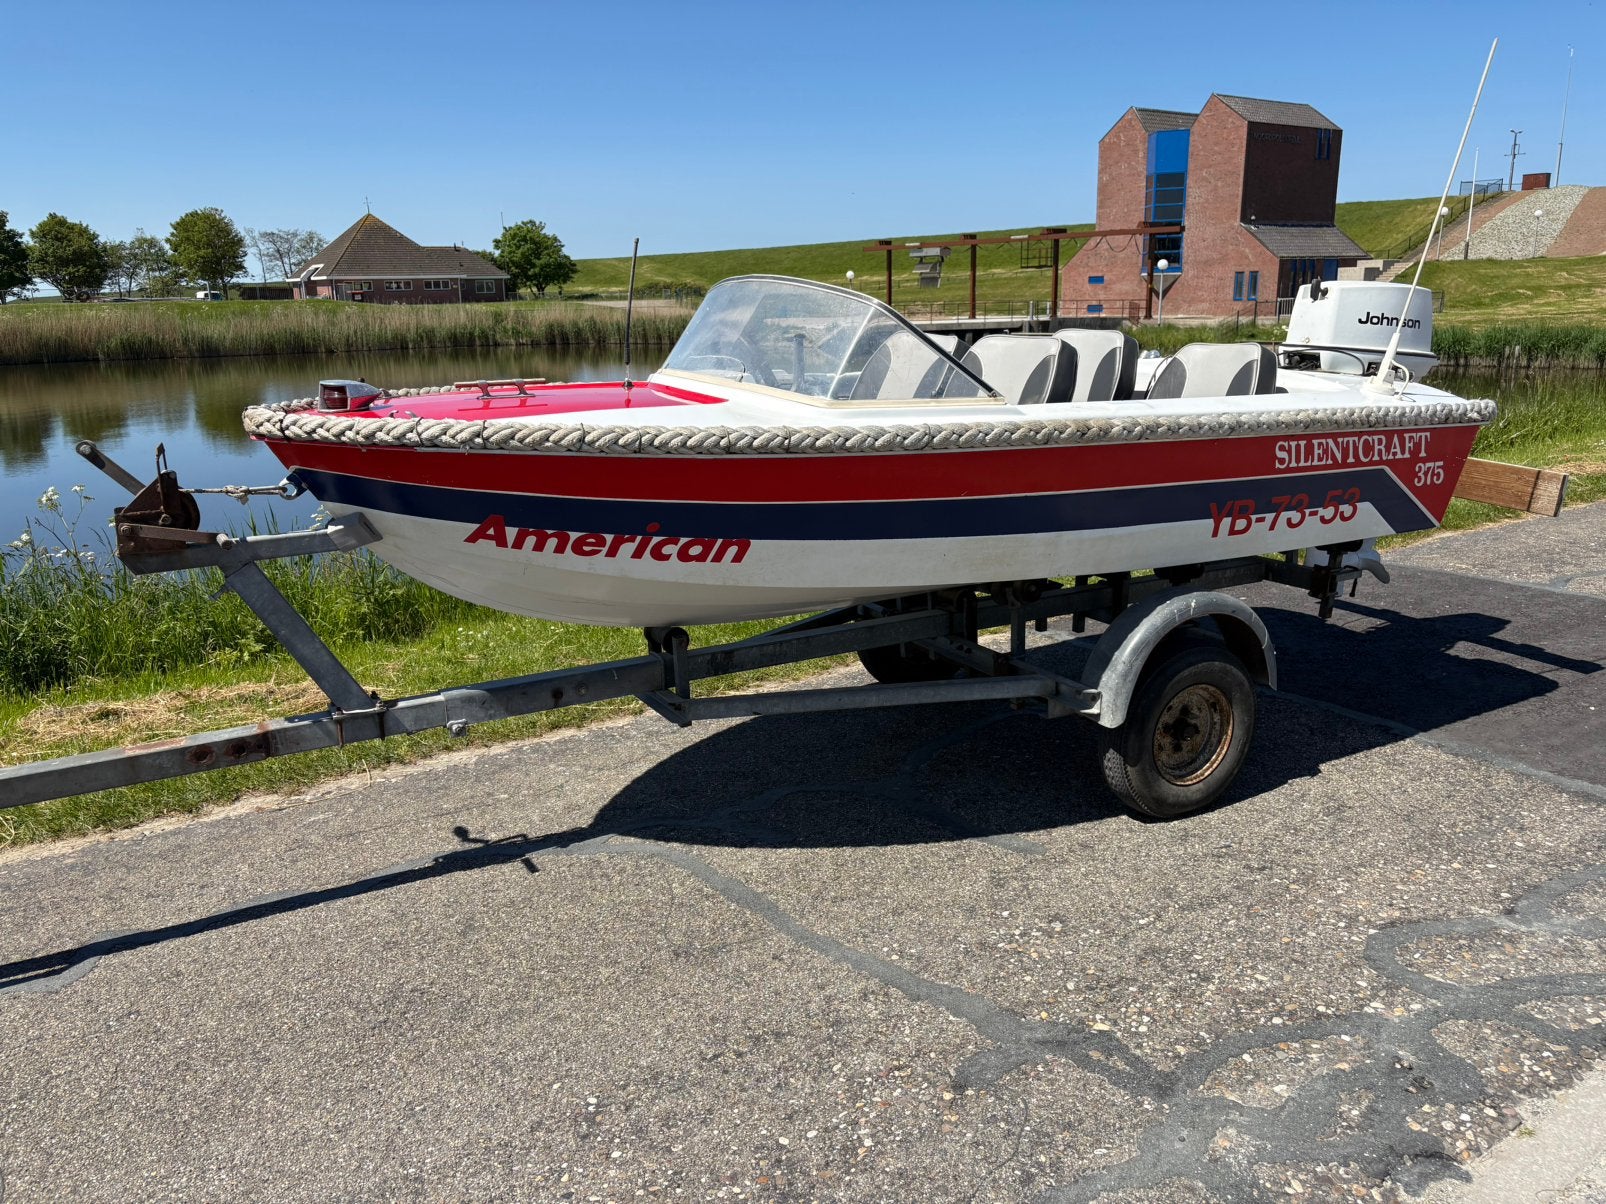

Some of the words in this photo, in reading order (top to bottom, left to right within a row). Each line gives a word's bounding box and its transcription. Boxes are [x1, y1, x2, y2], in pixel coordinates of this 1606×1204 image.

[1275, 432, 1430, 468] SILENTCRAFT
[1414, 461, 1444, 487] 375
[1209, 487, 1361, 538] YB-73-53
[463, 514, 751, 564] American
